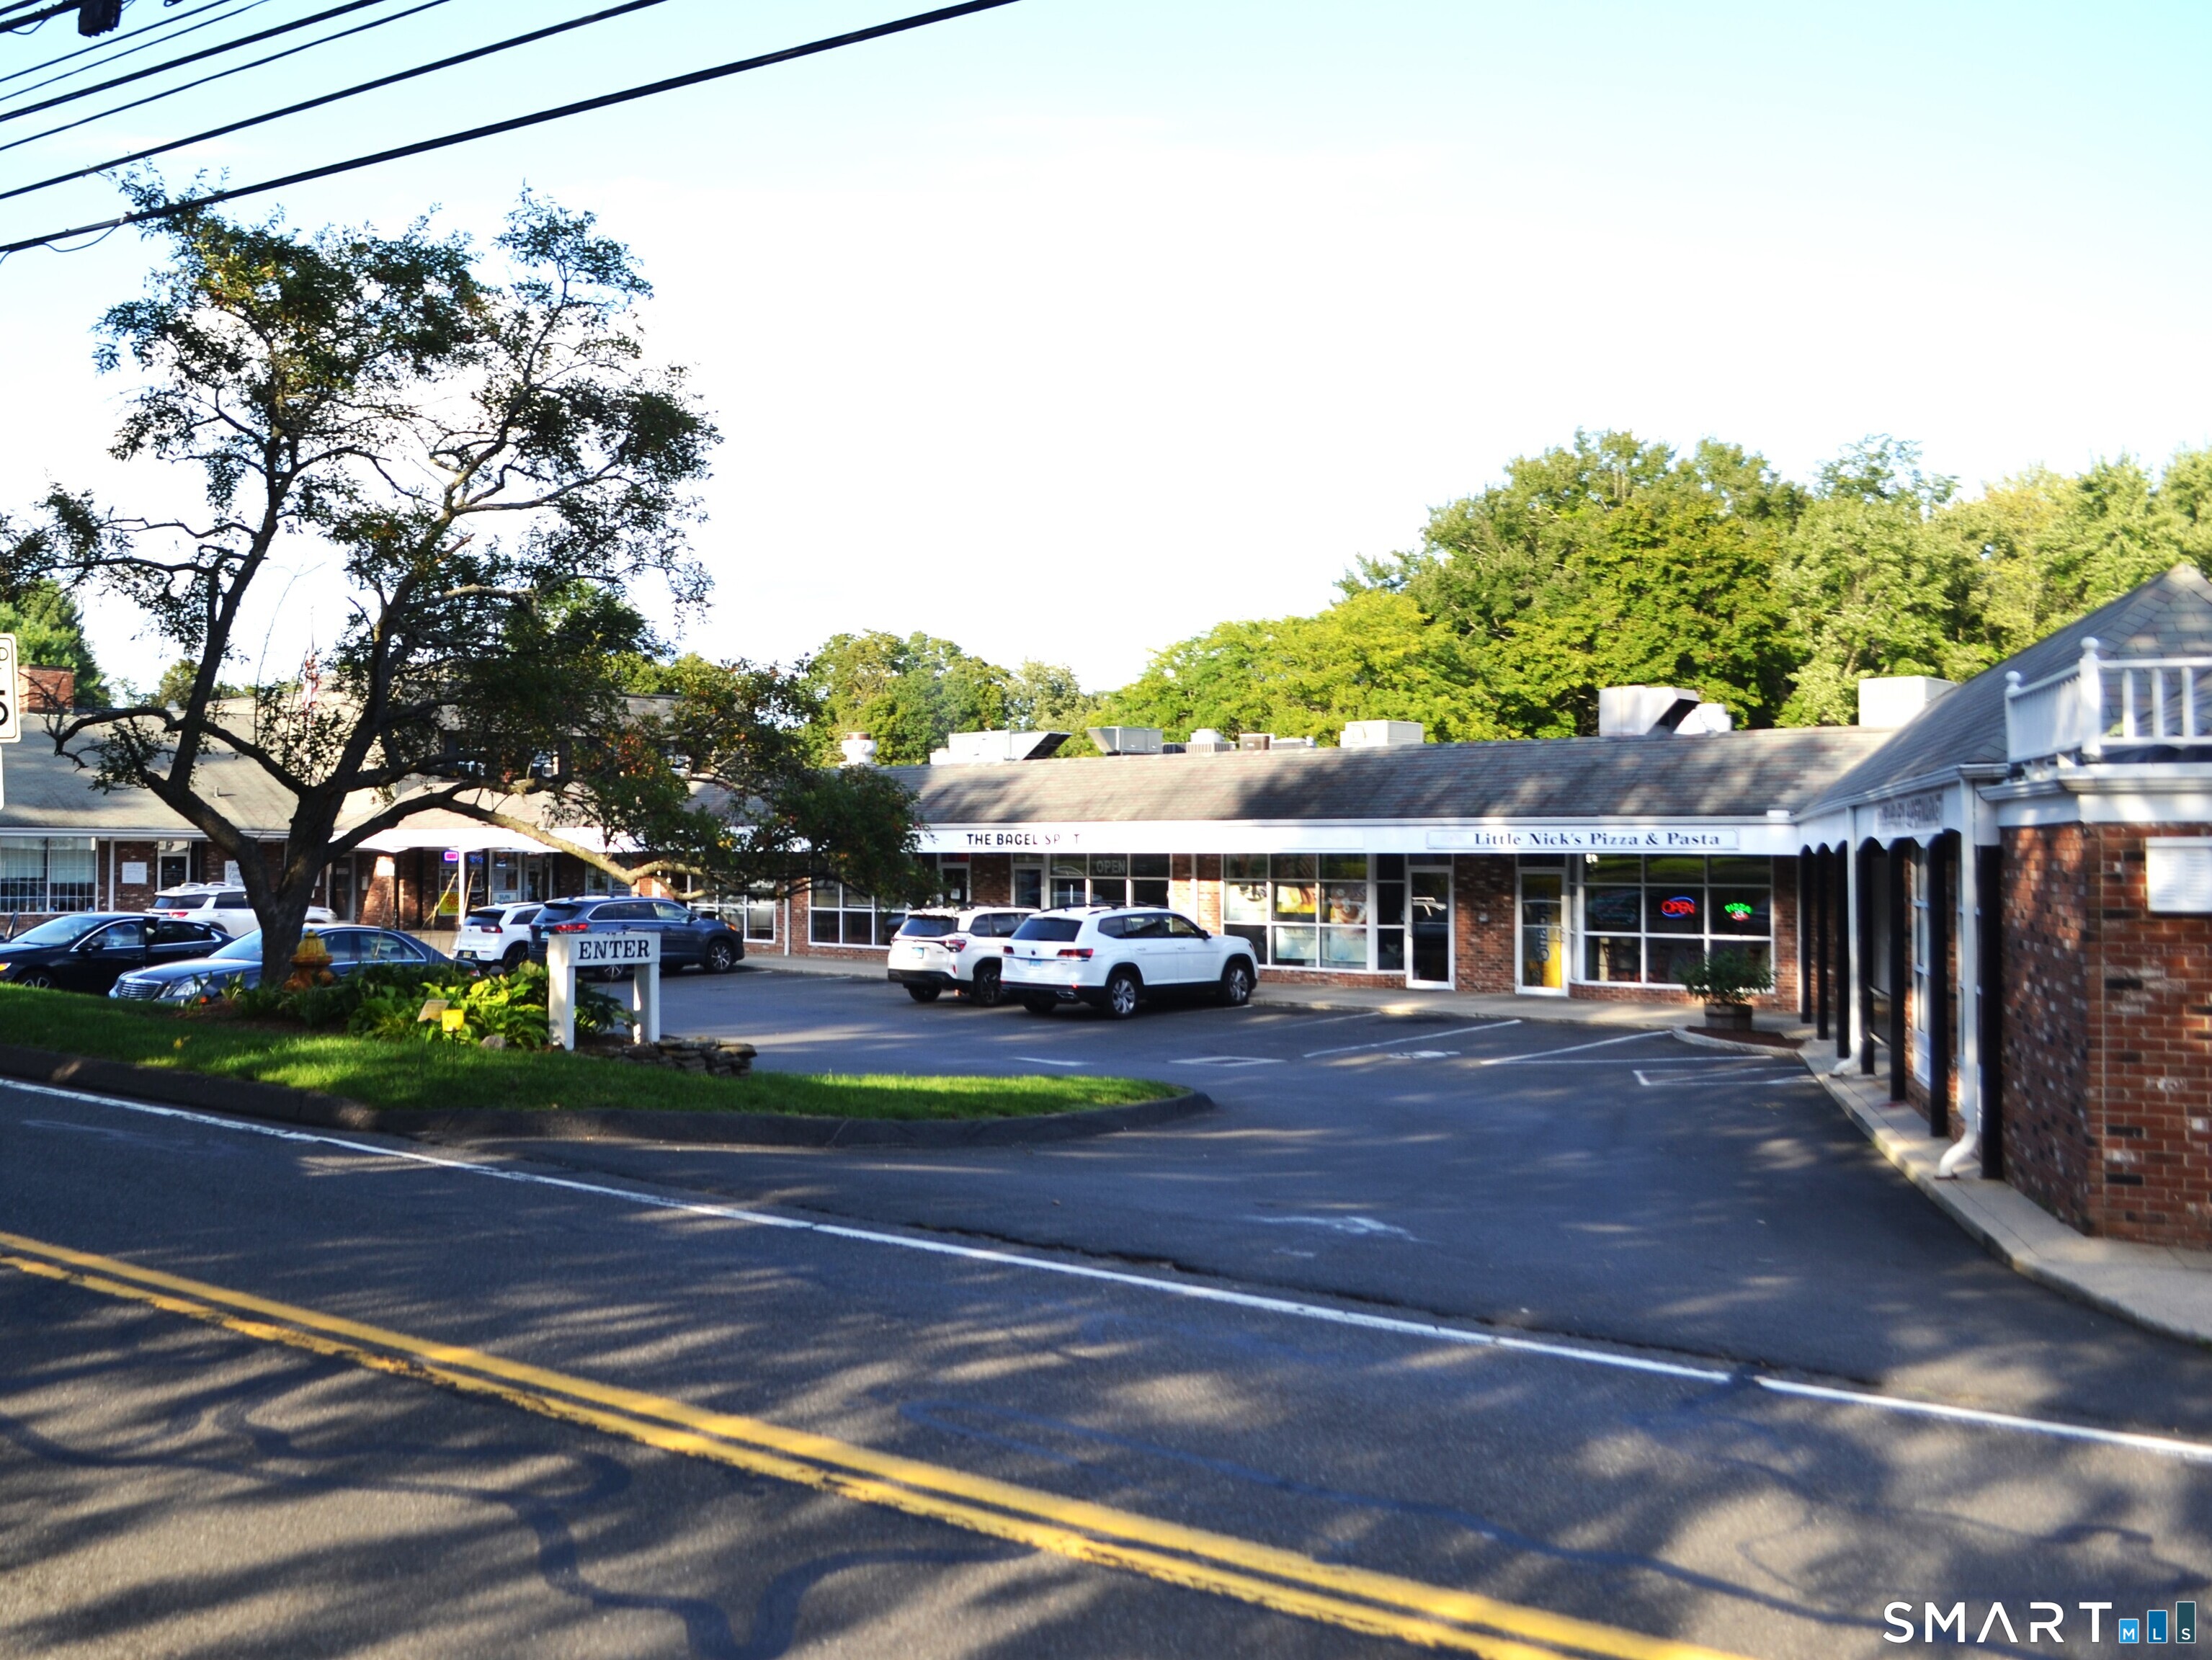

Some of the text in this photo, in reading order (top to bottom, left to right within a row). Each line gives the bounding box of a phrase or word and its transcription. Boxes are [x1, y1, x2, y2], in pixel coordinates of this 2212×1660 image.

[966, 834, 1080, 845] THE BAGEL SPT
[1475, 832, 1719, 845] Little Nick's Pizza & Pasta
[1096, 860, 1125, 874] OPEN
[1662, 901, 1695, 914] OPEN
[579, 940, 650, 960] ENTER
